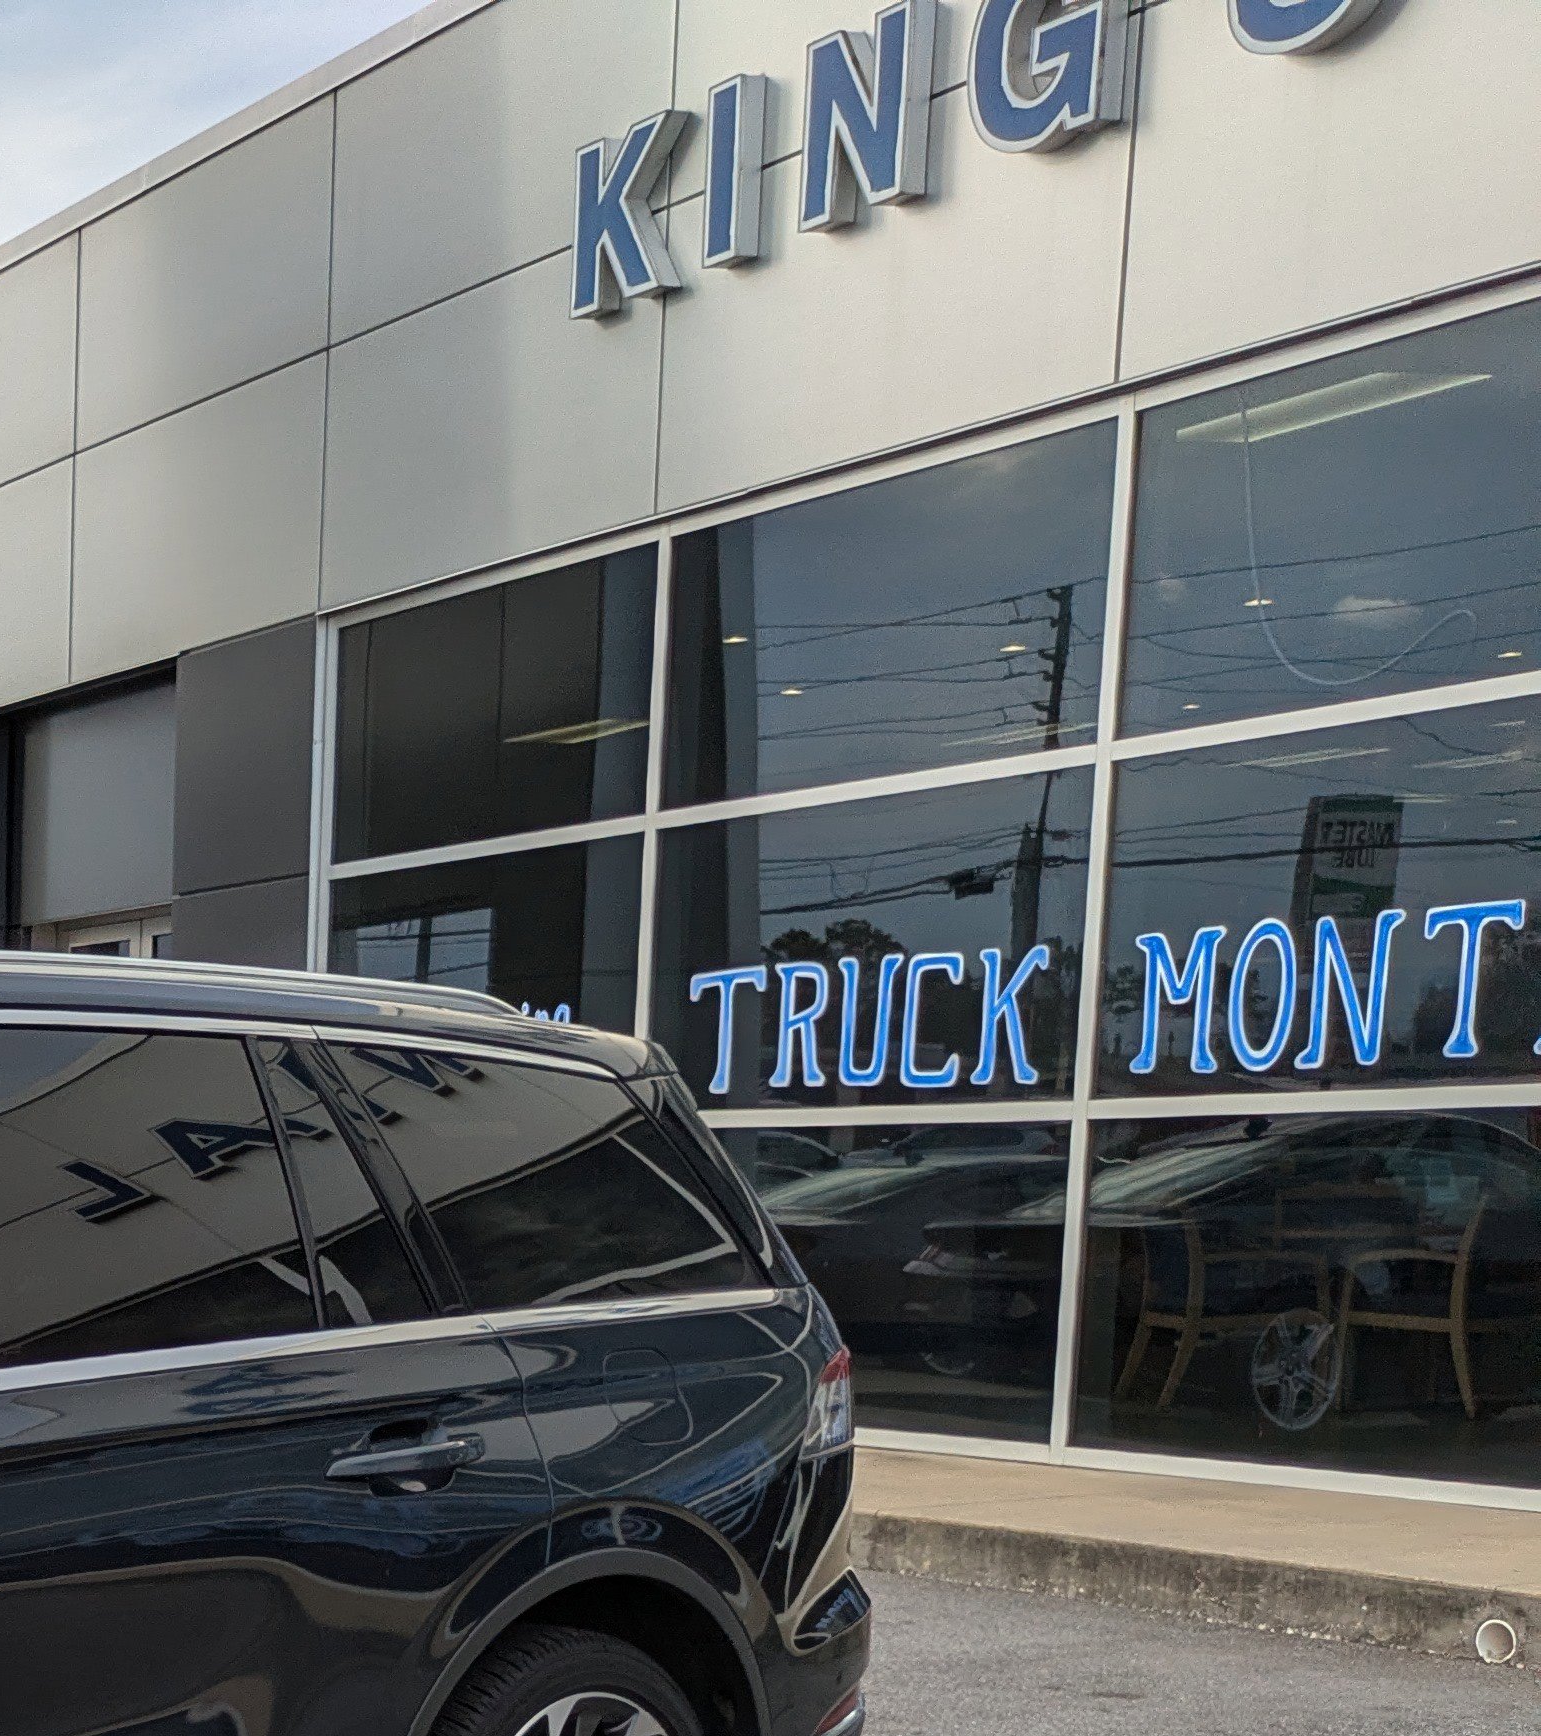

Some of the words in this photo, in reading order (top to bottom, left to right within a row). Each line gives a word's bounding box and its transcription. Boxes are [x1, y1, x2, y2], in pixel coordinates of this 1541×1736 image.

[569, 0, 1367, 320] KING
[690, 945, 1050, 1094] TRUCK
[1129, 899, 1541, 1075] MONT
